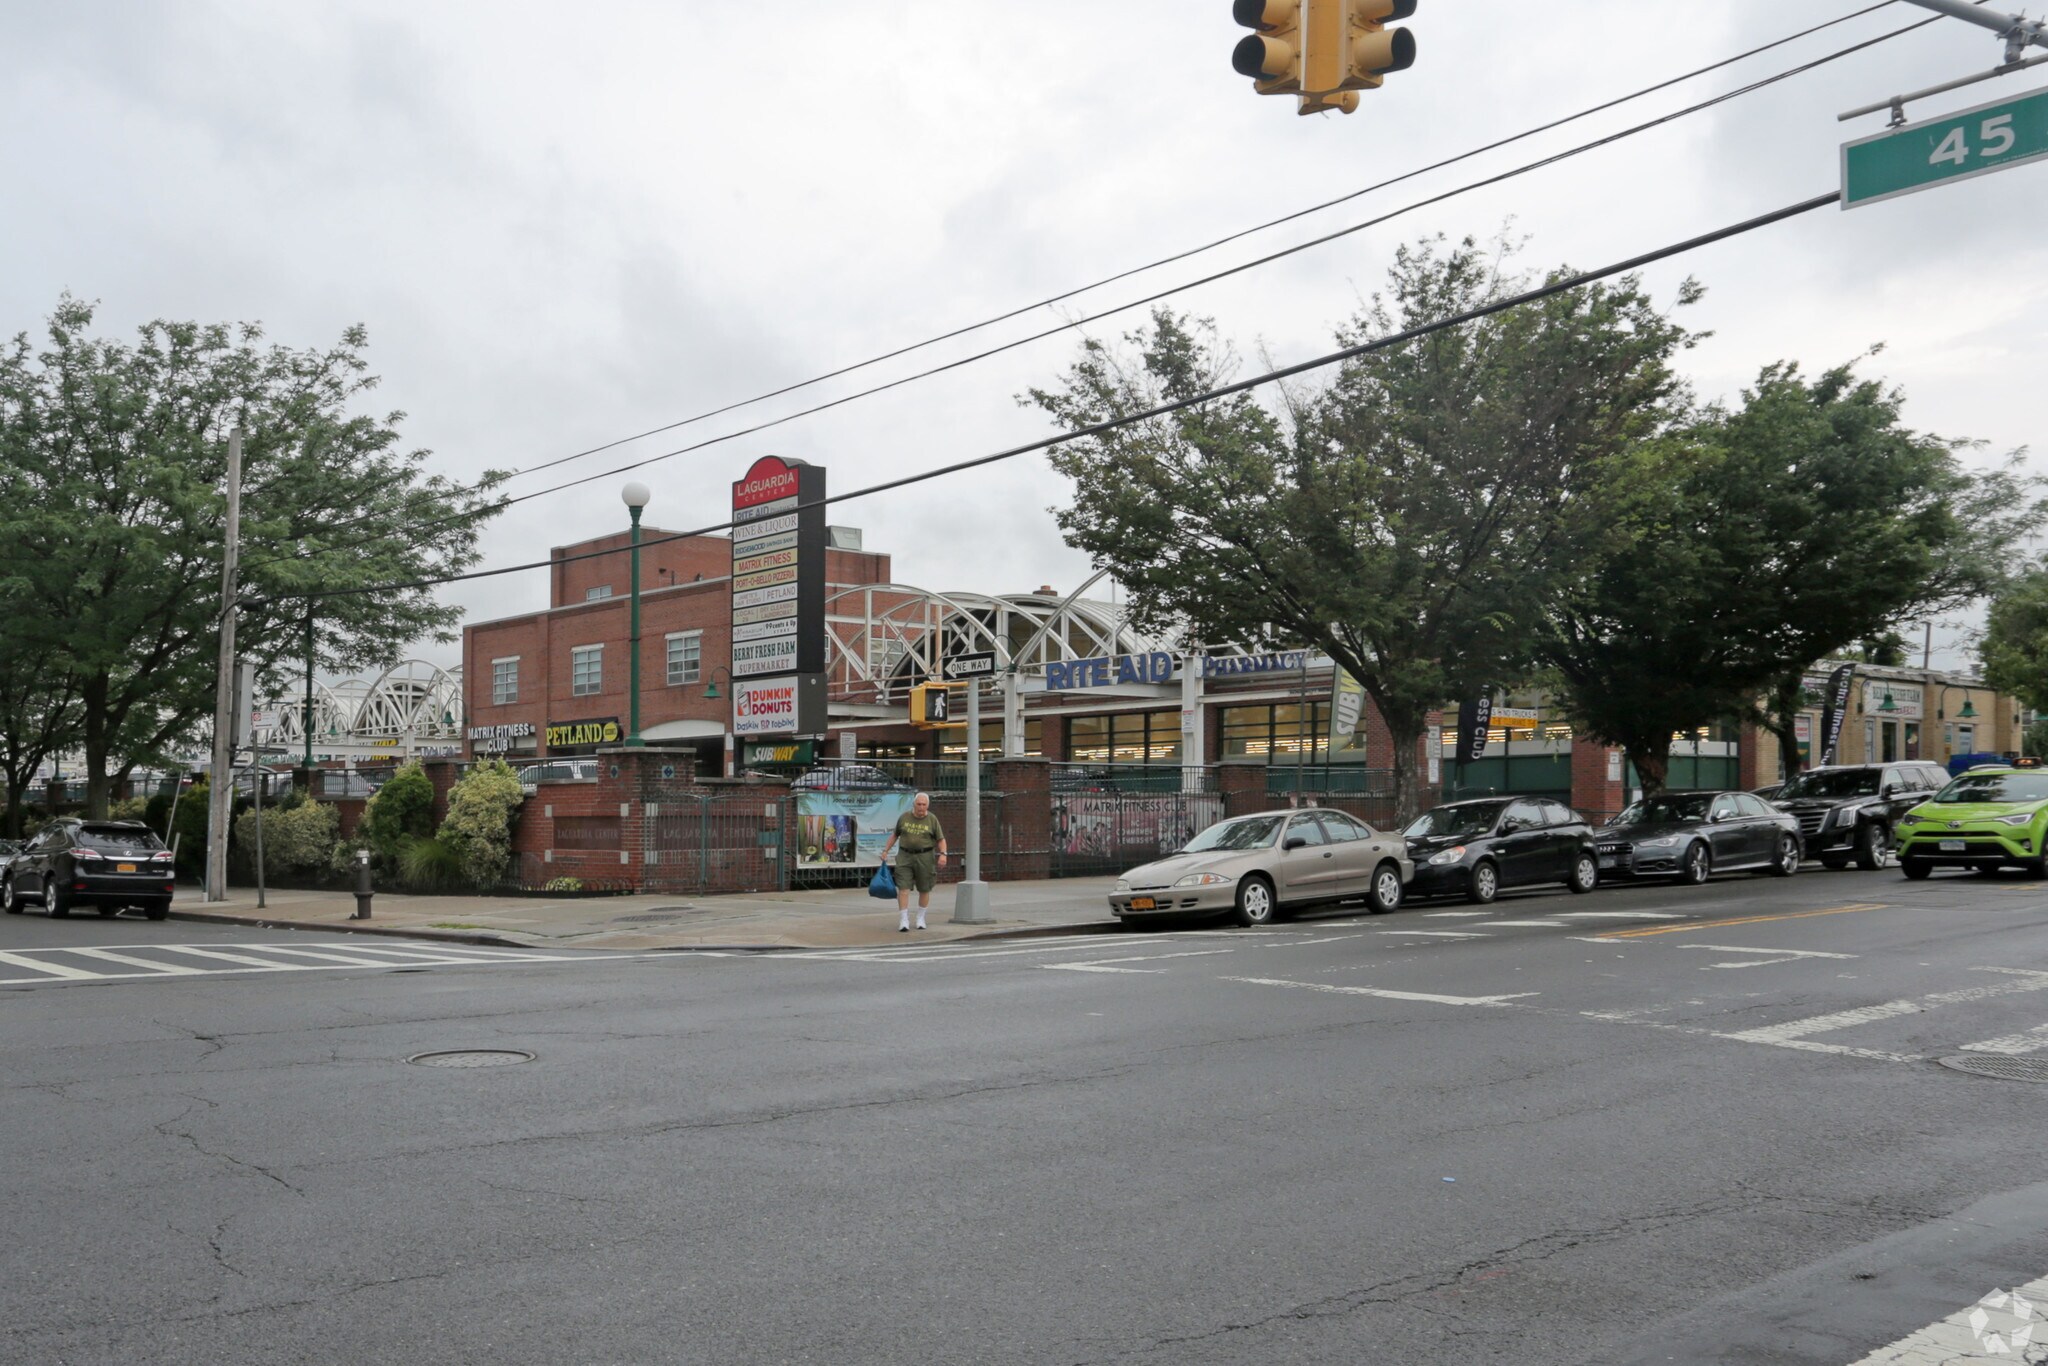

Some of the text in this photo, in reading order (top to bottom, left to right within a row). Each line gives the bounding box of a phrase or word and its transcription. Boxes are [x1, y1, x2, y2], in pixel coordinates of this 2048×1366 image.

[1928, 113, 2016, 165] 45
[737, 472, 795, 496] LAGUARDIA
[744, 487, 786, 502] CENTER
[736, 509, 754, 521] RITE
[755, 505, 770, 518] AID
[734, 515, 797, 539] WINE & LIQUOR
[735, 542, 766, 555] RIDGEWOOD
[738, 552, 792, 571] MATRIX FITNESS
[772, 569, 795, 582] PIZZERIA
[766, 586, 796, 600] PETLAND
[734, 640, 796, 661] BERRY FRESH FARM
[739, 658, 790, 674] SUPERMARKET
[951, 659, 989, 673] ONE WAY
[1047, 651, 1174, 690] RITE AID
[1202, 651, 1307, 678] PHARMACY
[752, 687, 795, 702] DUNKIN'
[752, 701, 793, 715] DONUTS
[467, 722, 529, 740] MATRIX FITNESS
[736, 720, 759, 731] baskin
[771, 718, 795, 729] robbins
[545, 723, 602, 746] PETLAND
[487, 739, 509, 753] CLUB
[1471, 727, 1486, 759] club
[752, 745, 797, 761] SUBWAY
[1083, 801, 1120, 812] MATRIX
[1124, 801, 1160, 812] FITNESS
